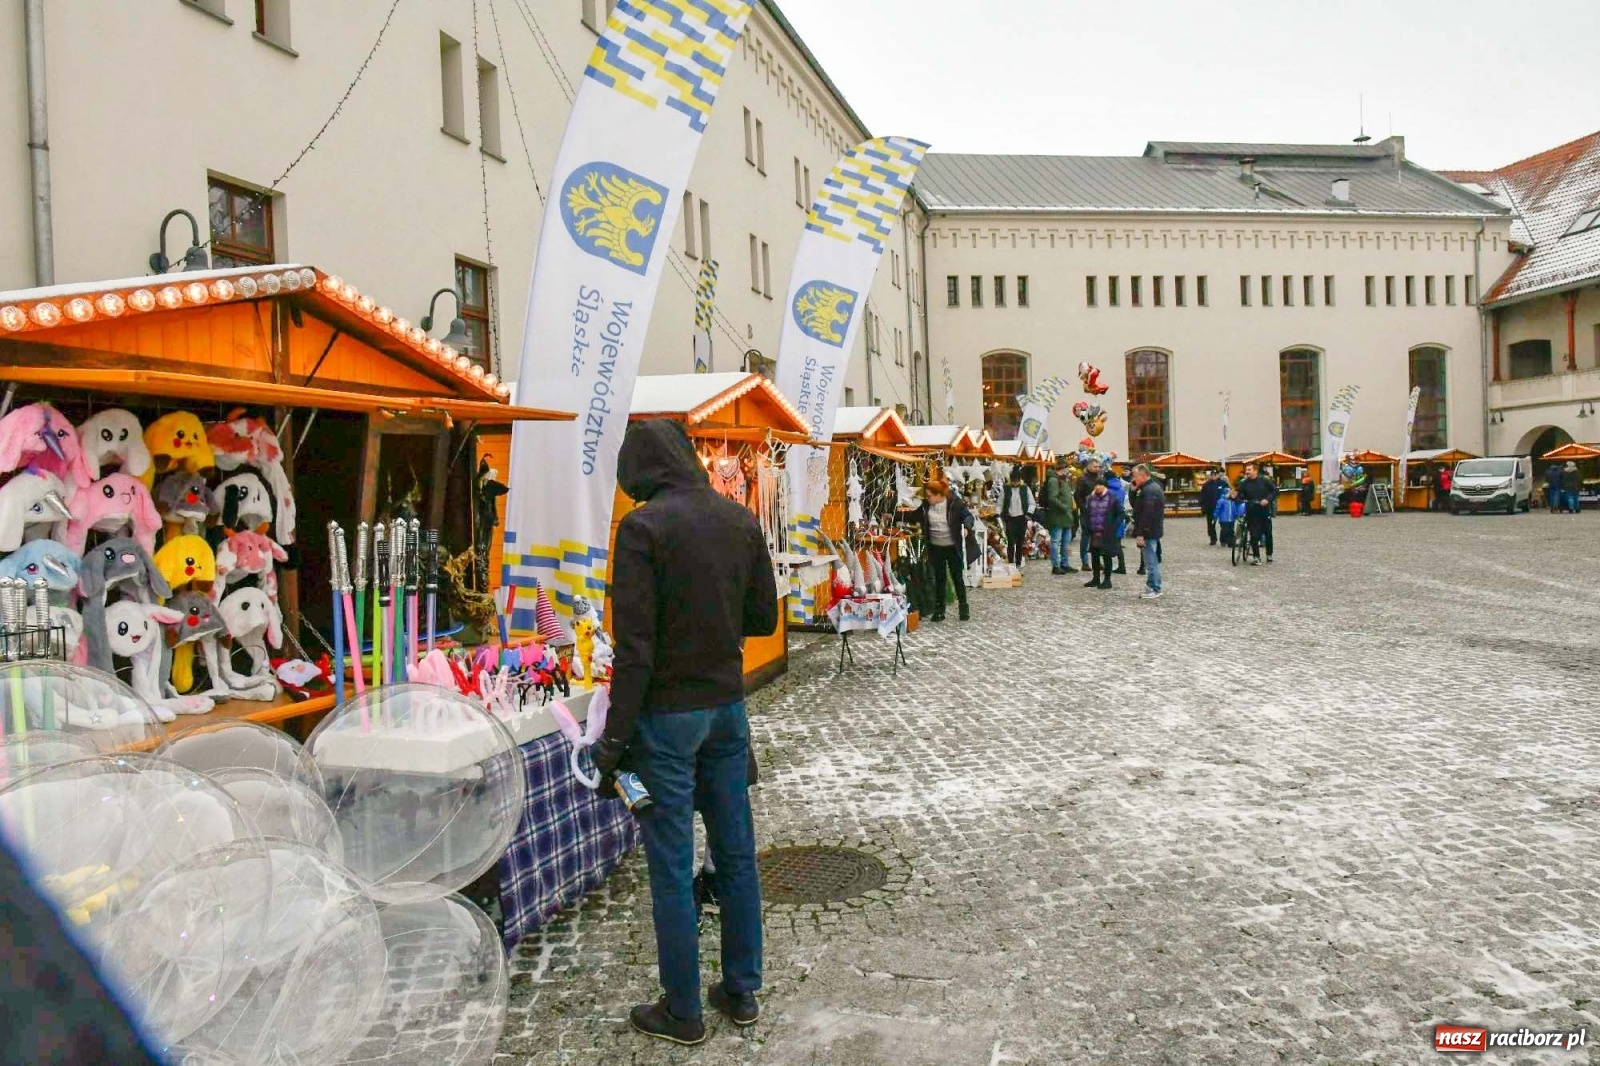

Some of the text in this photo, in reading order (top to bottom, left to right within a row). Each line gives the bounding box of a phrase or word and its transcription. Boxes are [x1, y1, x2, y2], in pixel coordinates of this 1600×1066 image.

[571, 285, 604, 378] Śląskie
[582, 301, 632, 476] Województwo
[797, 356, 819, 415] Śląskie
